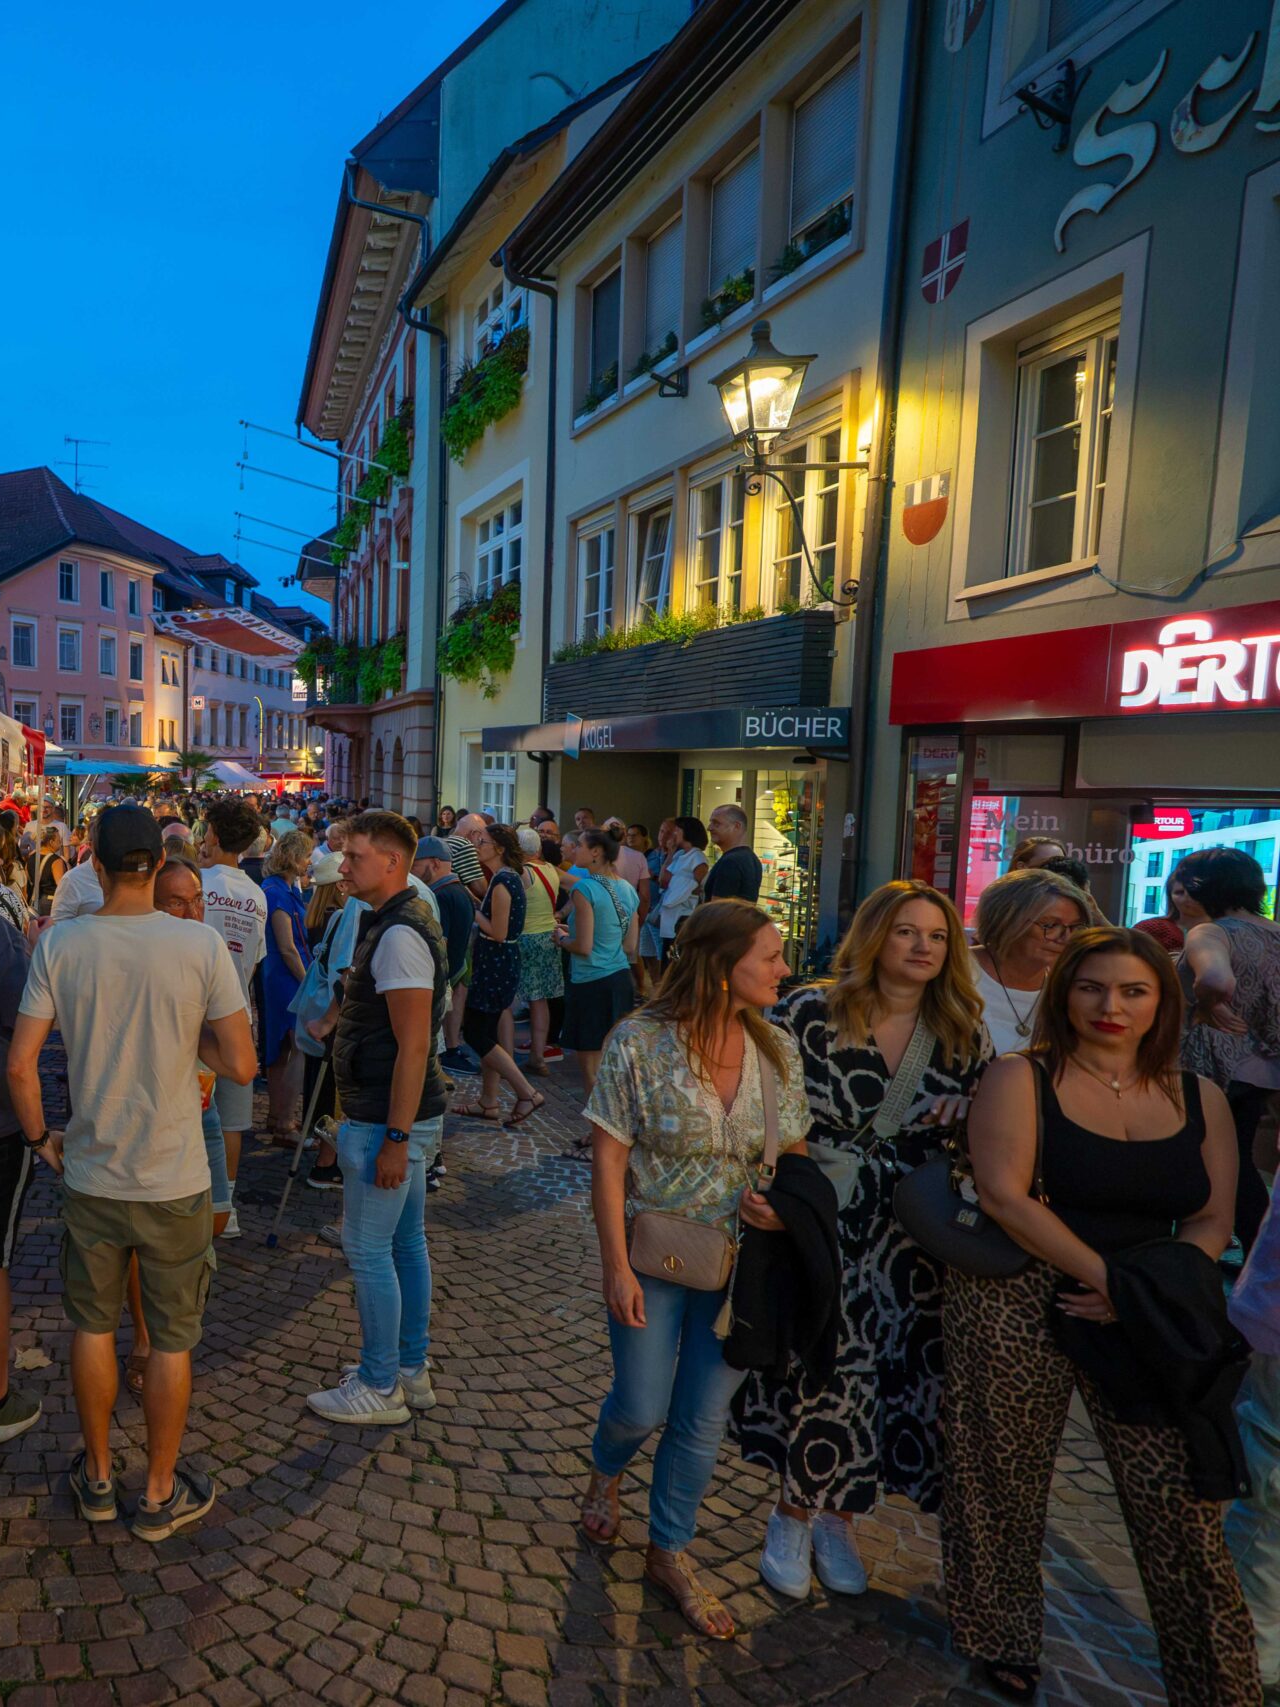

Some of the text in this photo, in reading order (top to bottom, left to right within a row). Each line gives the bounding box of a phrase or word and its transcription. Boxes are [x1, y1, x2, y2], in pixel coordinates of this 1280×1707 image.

[1119, 632, 1280, 708] DERT
[745, 712, 843, 739] BÜCHER
[923, 747, 986, 760] DERTR
[985, 810, 1060, 832] Mein
[1154, 816, 1186, 826] RTOUR
[981, 842, 1137, 865] Rebüro
[207, 891, 243, 911] Ocean
